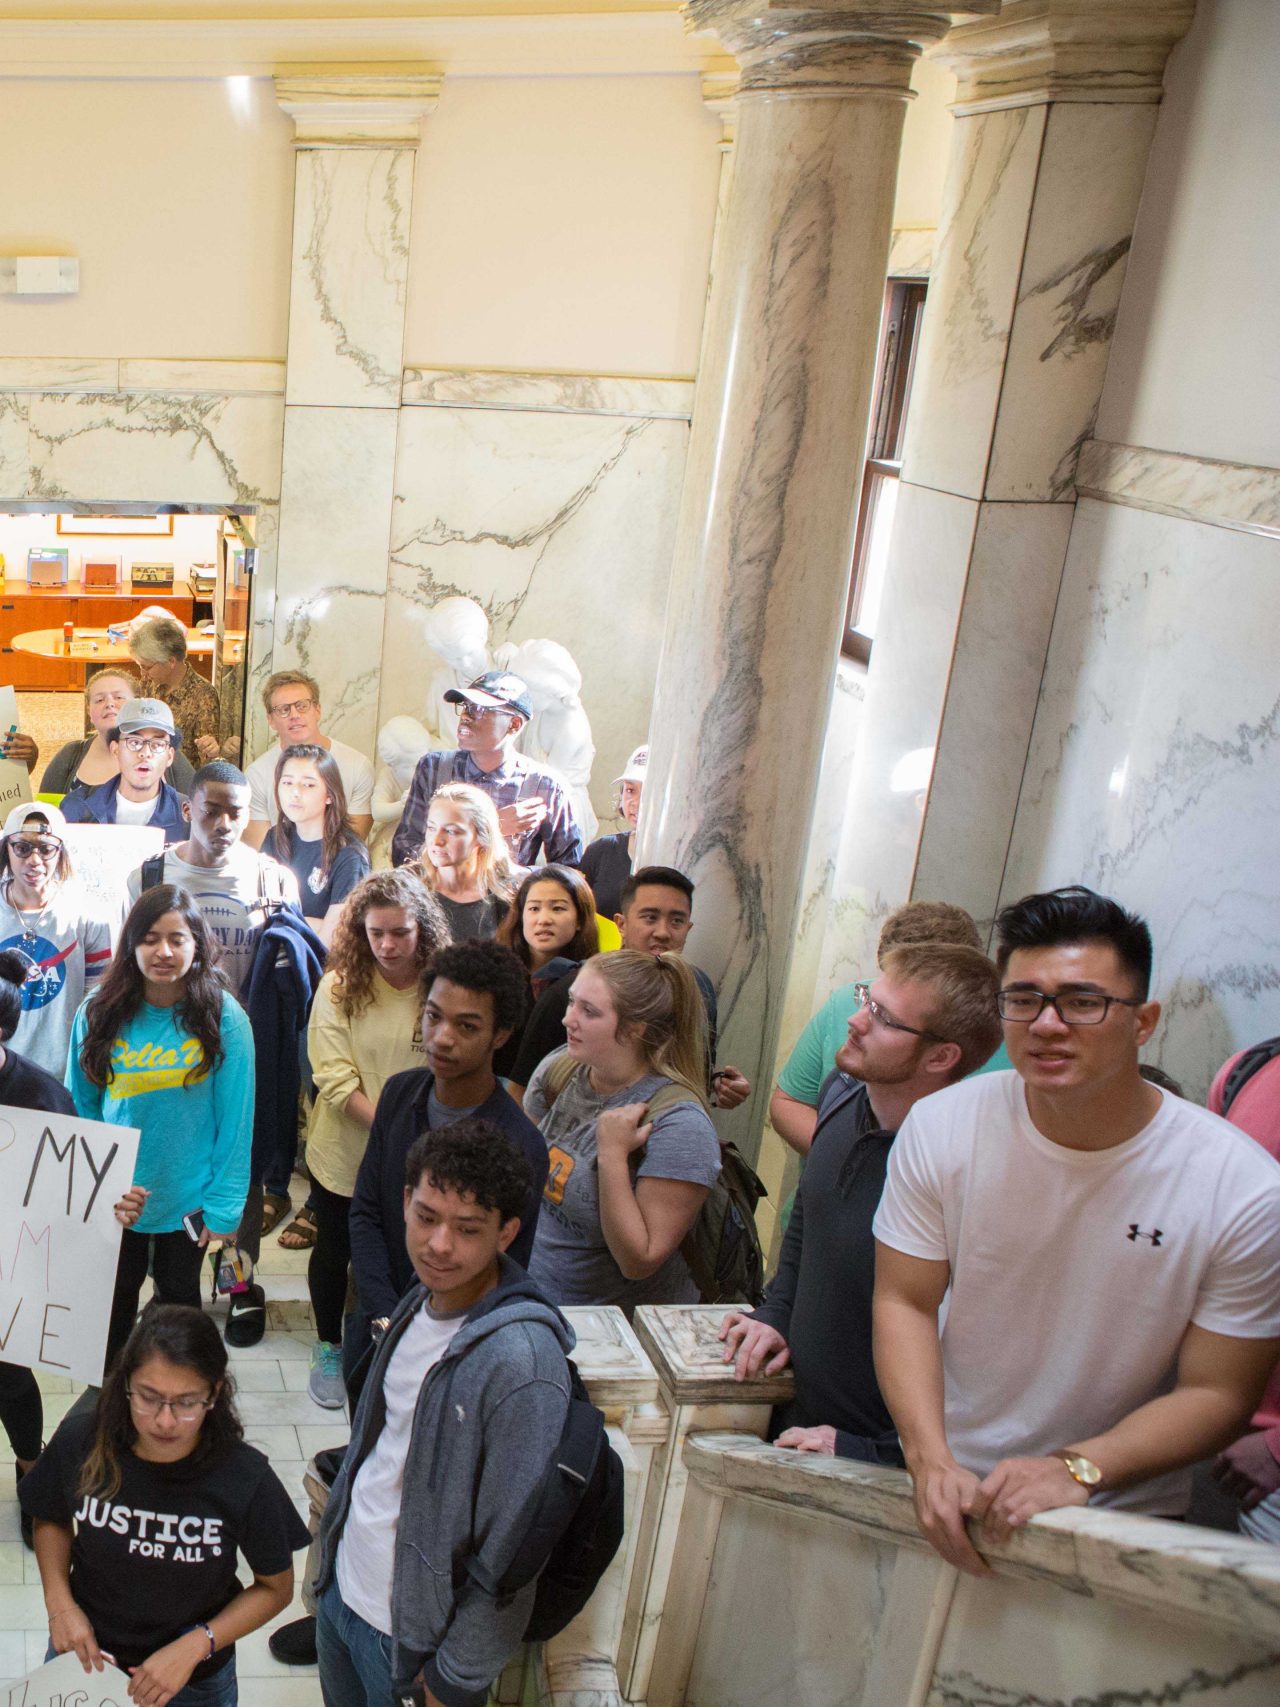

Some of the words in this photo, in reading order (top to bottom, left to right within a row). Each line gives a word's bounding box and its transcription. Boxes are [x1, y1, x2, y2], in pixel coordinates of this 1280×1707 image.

[22, 1126, 120, 1223] MY
[75, 1495, 223, 1545] JUSTICE
[128, 1539, 165, 1559] FOR
[173, 1545, 205, 1562] ALL
